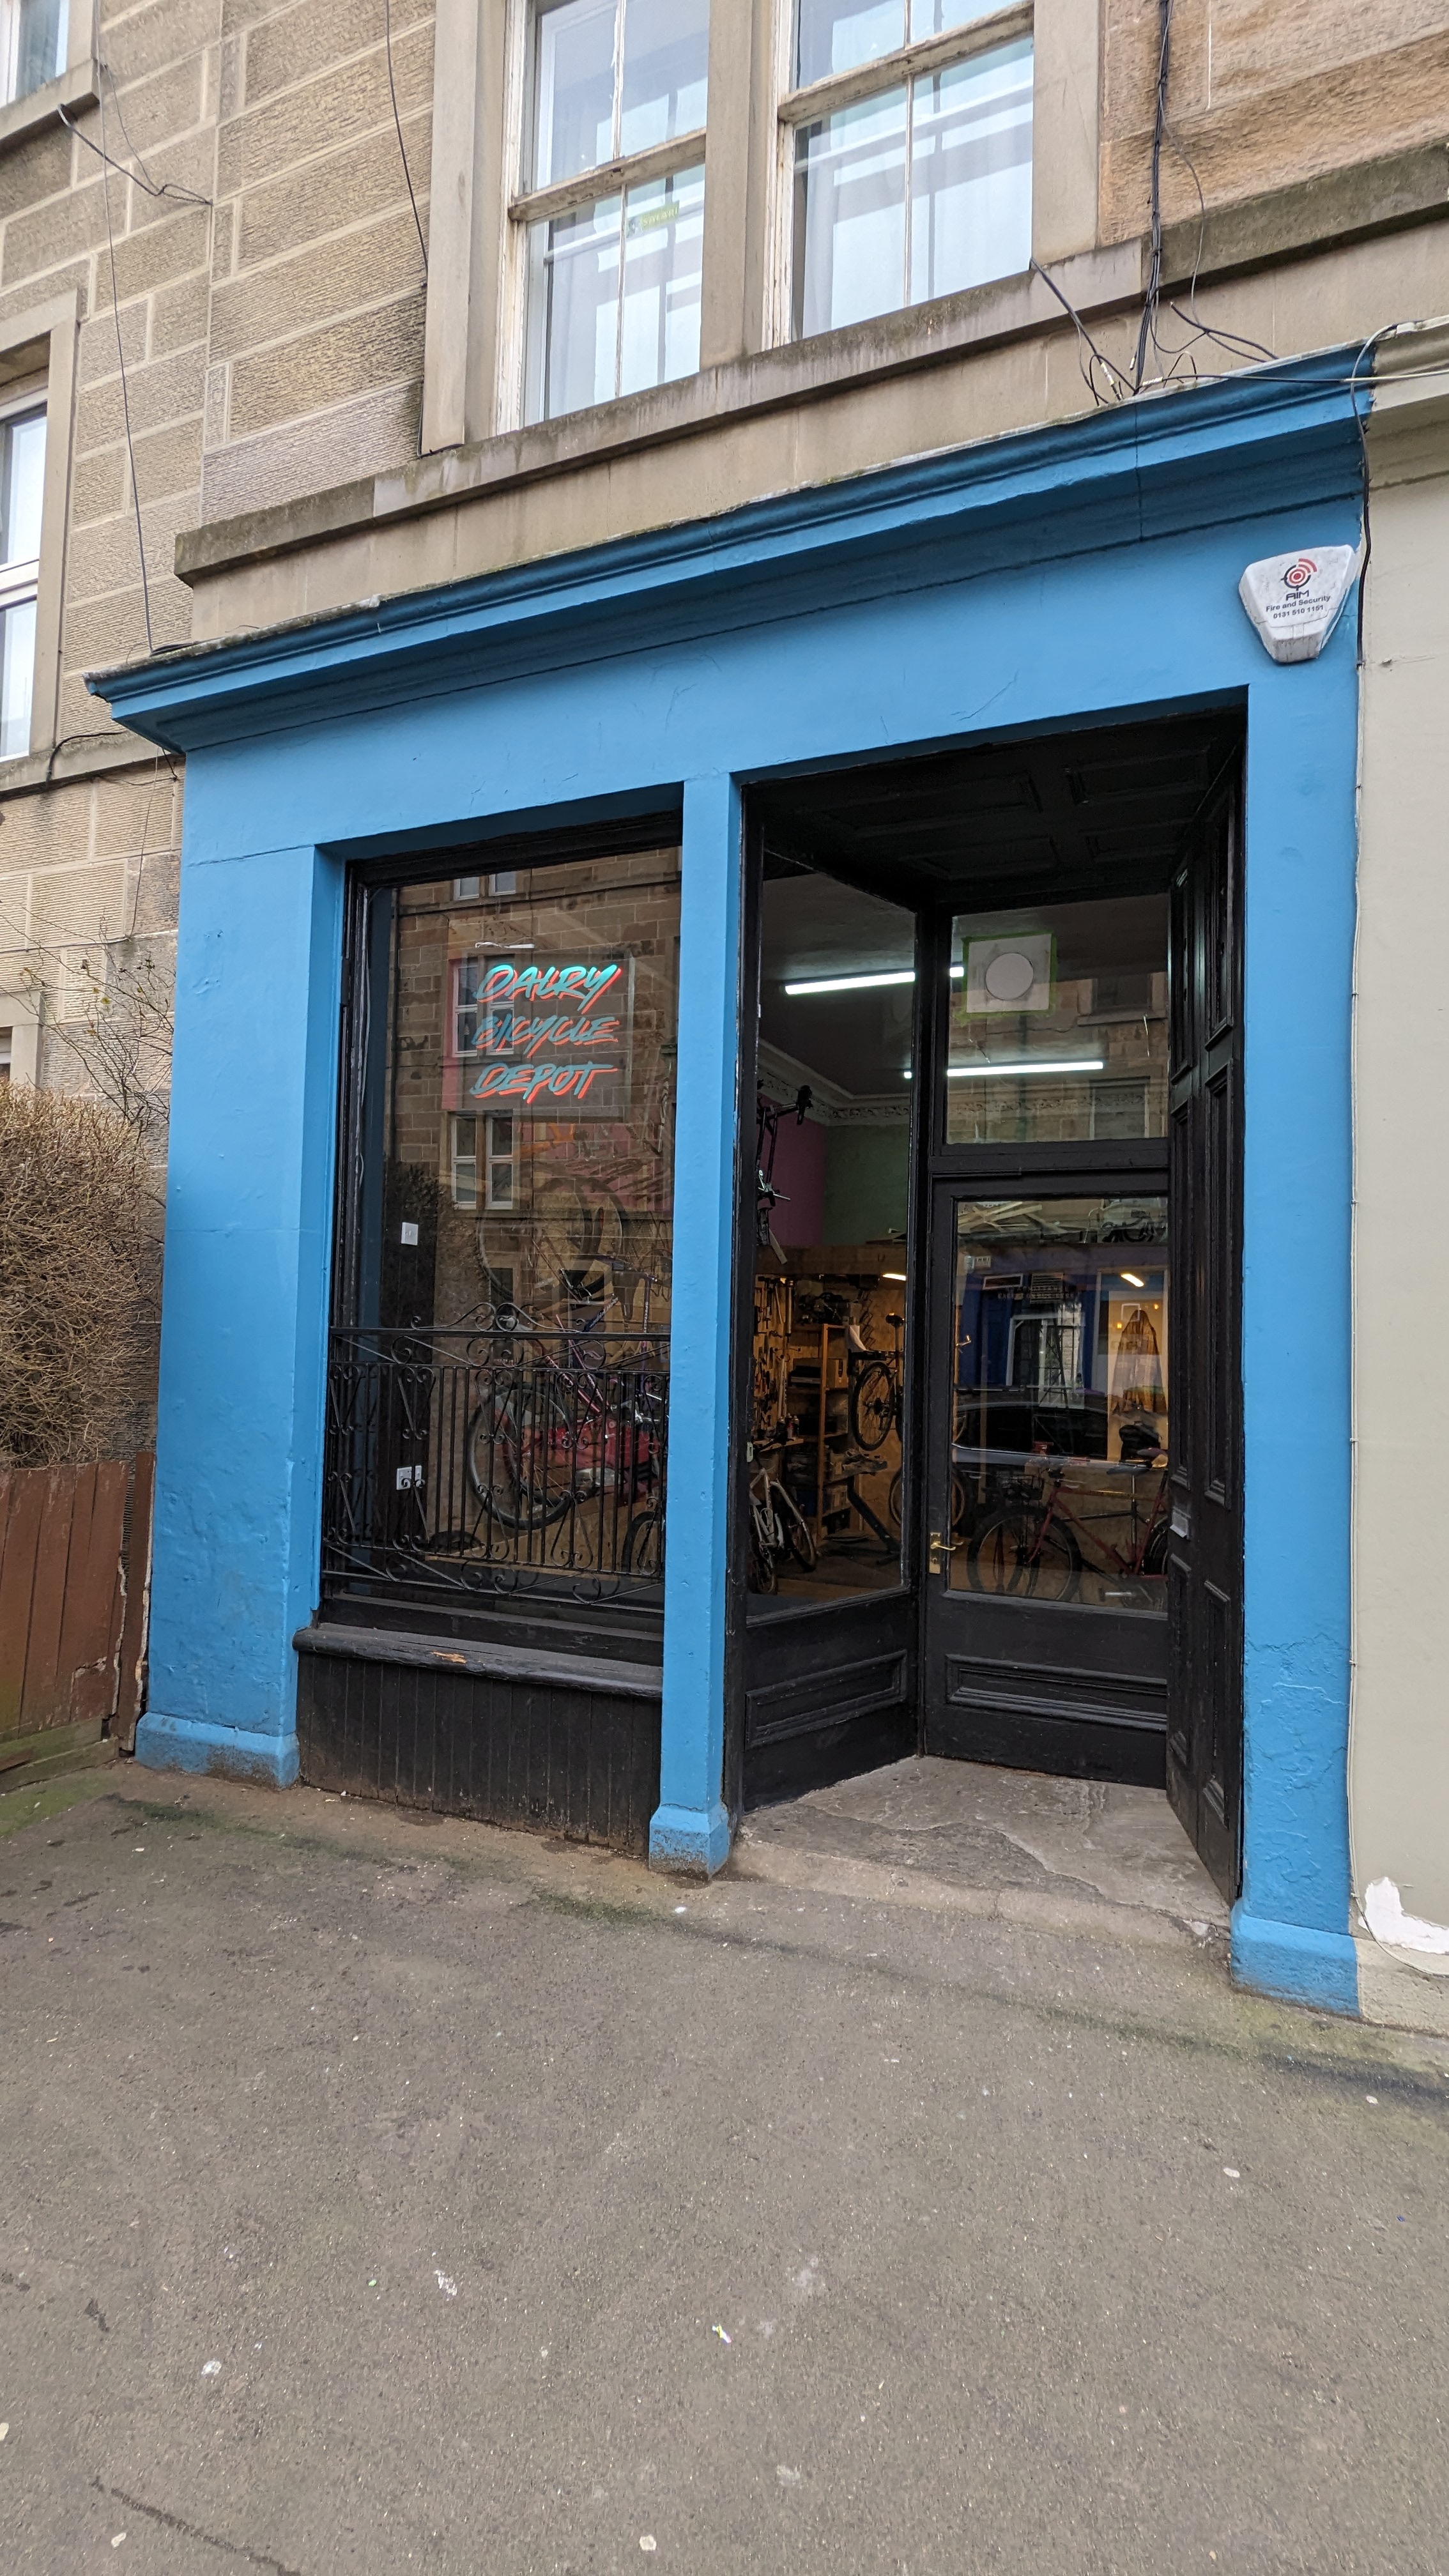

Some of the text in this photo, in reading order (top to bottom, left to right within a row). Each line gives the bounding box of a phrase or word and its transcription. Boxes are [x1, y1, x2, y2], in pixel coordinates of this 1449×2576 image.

[1285, 590, 1309, 601] AIM
[1298, 595, 1331, 606] Security
[473, 964, 622, 1014] DALRY
[471, 1014, 620, 1058] BICYCLE
[469, 1061, 618, 1104] DEPOT
